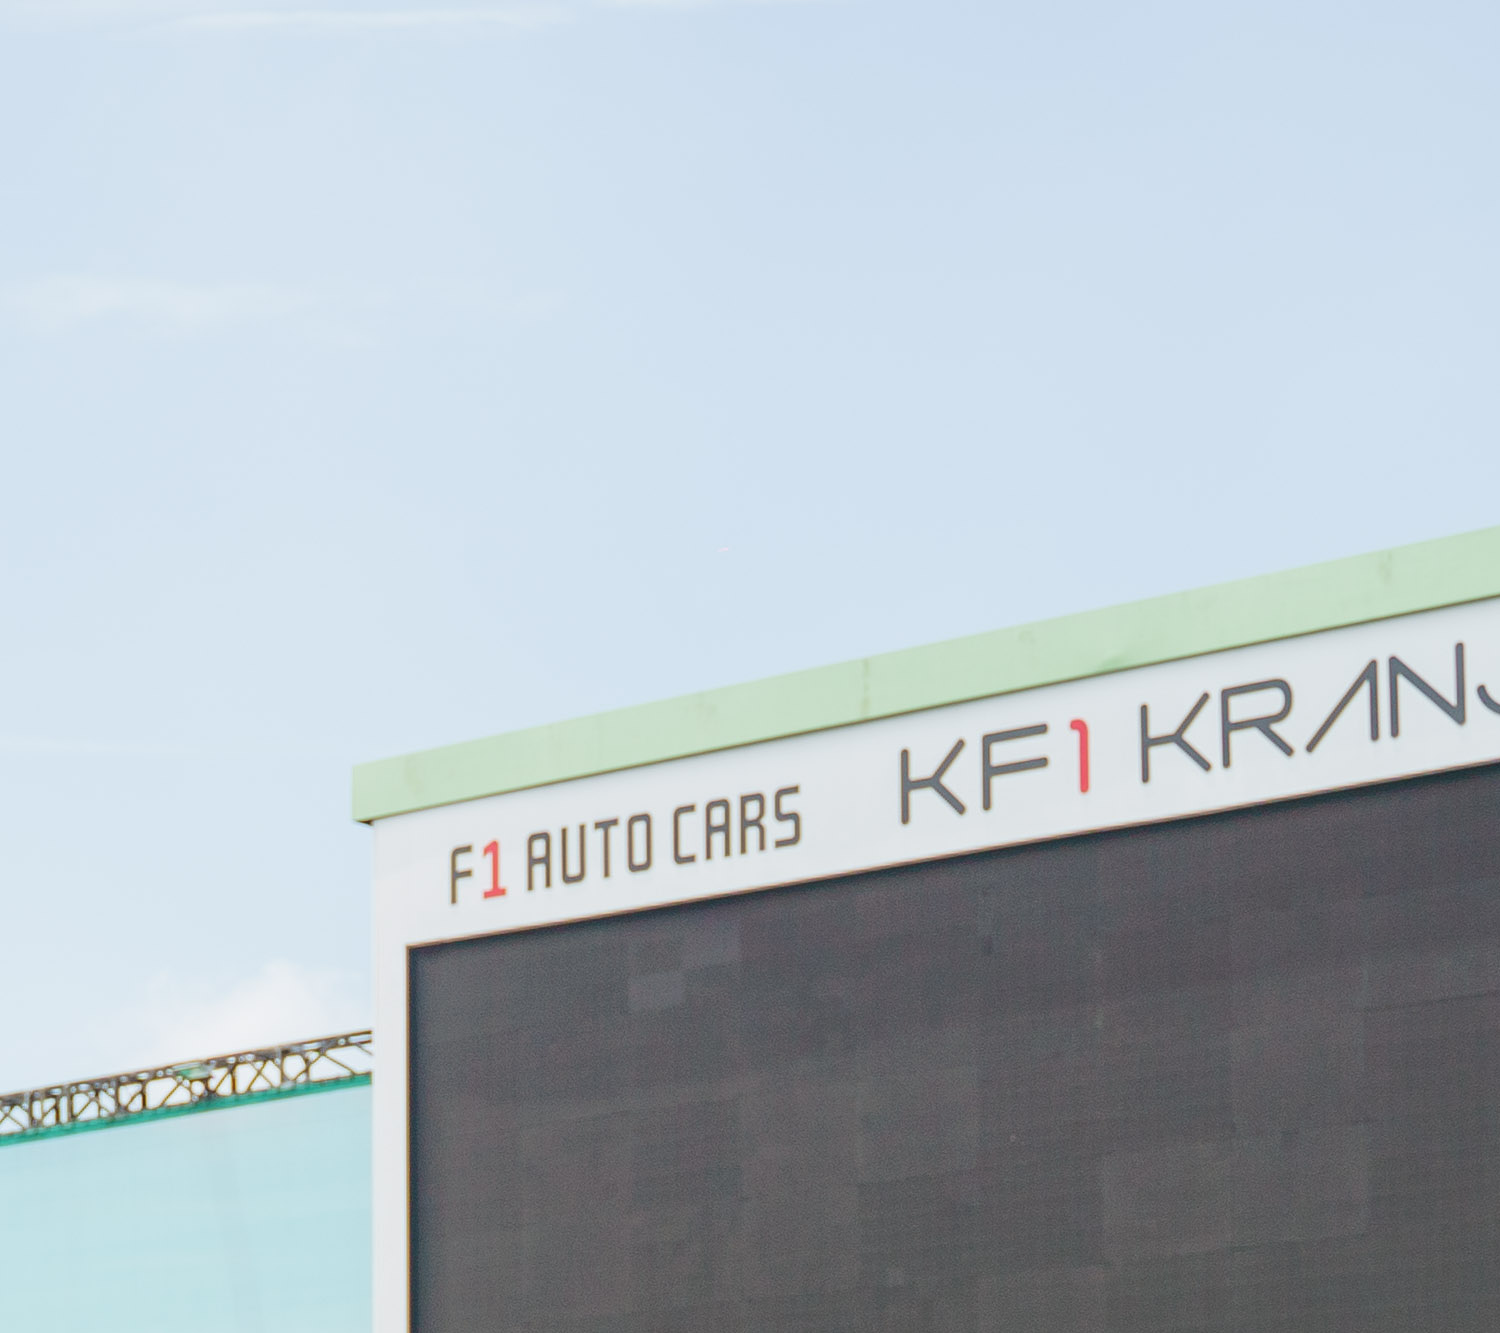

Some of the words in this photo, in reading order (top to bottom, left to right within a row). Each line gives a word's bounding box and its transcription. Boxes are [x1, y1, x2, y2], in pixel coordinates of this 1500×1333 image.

[899, 719, 1091, 826] KF1
[450, 839, 508, 905] F1
[526, 811, 653, 892] AUTO
[672, 784, 802, 867] CARS
